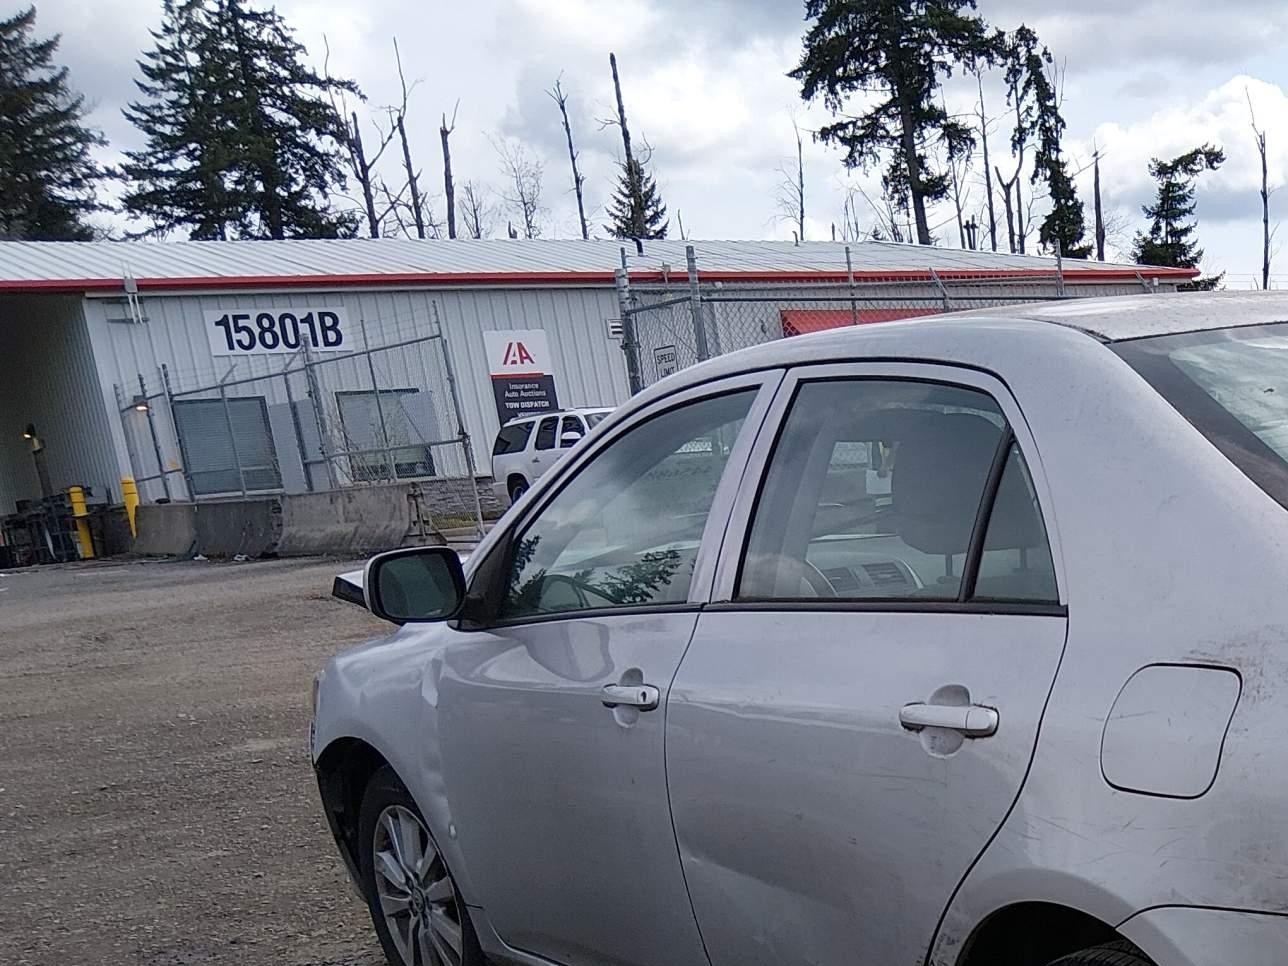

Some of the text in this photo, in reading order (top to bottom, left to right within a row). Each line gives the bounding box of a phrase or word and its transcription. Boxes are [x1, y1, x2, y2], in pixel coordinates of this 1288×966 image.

[214, 311, 343, 351] 15801B
[504, 389, 547, 398] Auto Auctions
[520, 400, 550, 409] DISPATCH
